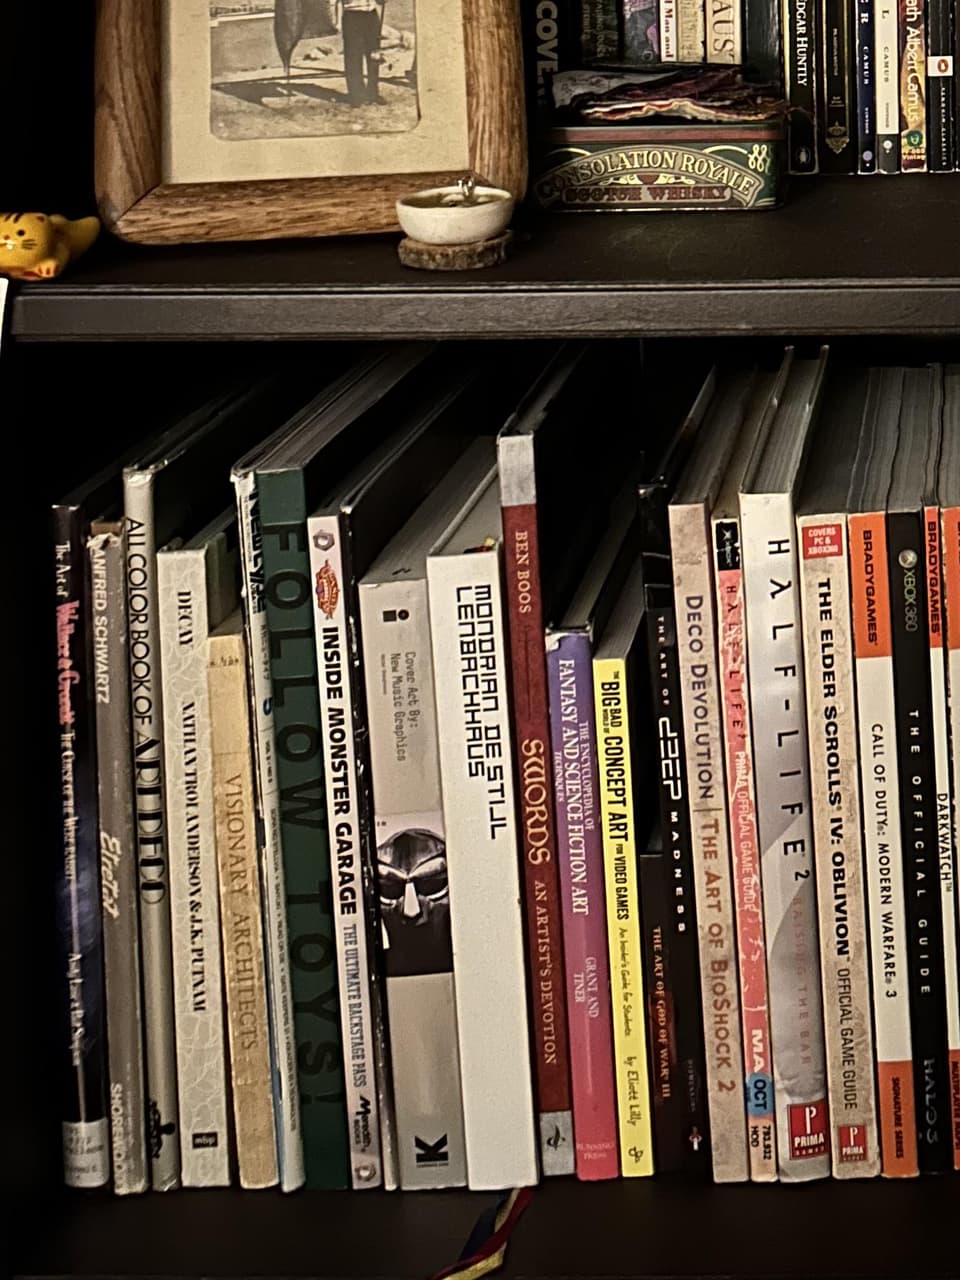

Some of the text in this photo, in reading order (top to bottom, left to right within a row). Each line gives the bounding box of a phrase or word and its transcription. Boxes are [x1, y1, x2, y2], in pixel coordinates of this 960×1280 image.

[663, 7, 675, 34] Man
[664, 35, 675, 58] and
[796, 36, 810, 86] HUNTLY
[907, 25, 923, 122] Albert Camus
[176, 590, 194, 649] DECAY
[515, 530, 533, 614] BEN BOOS
[95, 615, 111, 705] SCHWARTZ
[391, 652, 409, 762] New Music Graphics
[405, 651, 420, 728] Cover Art By:
[455, 585, 486, 779] LENBACHHAUS
[686, 595, 714, 801] DECO DEVOLUTION
[321, 626, 357, 916] INSIDE MONSTER GARAGE
[520, 738, 551, 866] SWORDS
[558, 659, 590, 917] FANTASY AND SCIENCE FICTION ART
[579, 720, 596, 832] THE ENCYCLOPEDIA OF
[604, 735, 630, 842] CONCEPT ART
[614, 856, 631, 921] VIDEO GAMES
[670, 810, 688, 935] MADNESS
[908, 709, 932, 995] THE OFFICIAL GUIDE
[225, 773, 258, 1050] VISIONARY ARCHITECTS
[573, 972, 586, 1004] TINER
[585, 956, 600, 1019] GRANT AND
